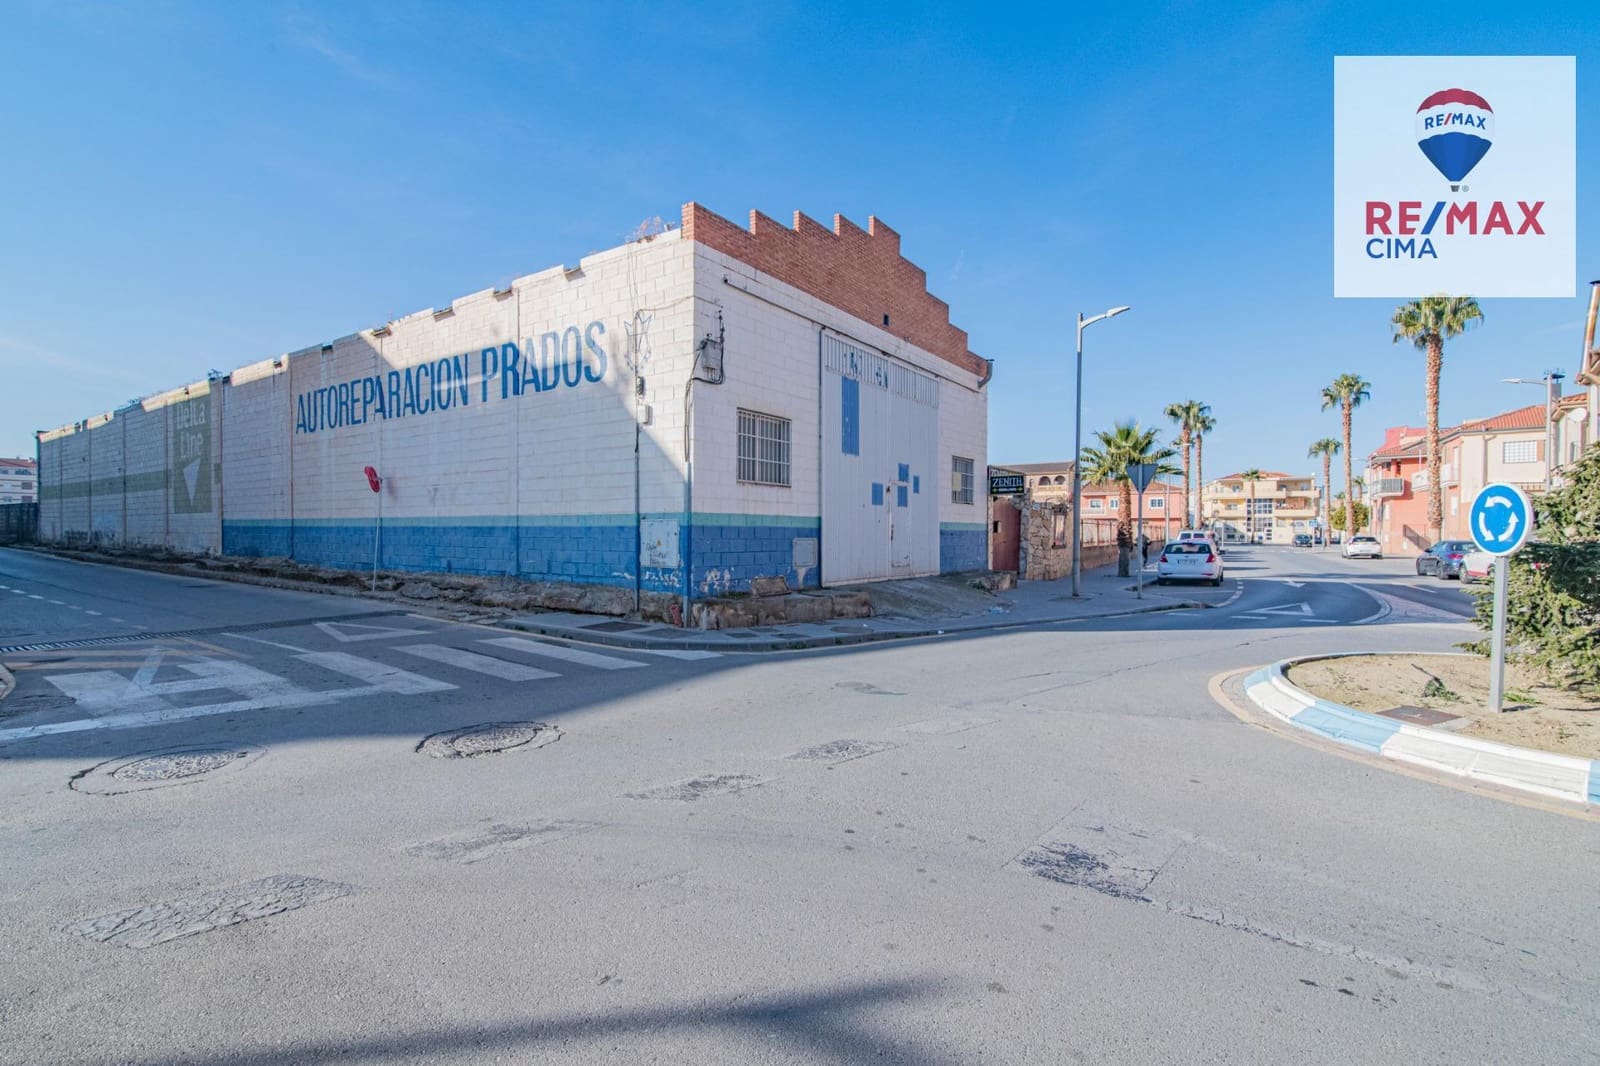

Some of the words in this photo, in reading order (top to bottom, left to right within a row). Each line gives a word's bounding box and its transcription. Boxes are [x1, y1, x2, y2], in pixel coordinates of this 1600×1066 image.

[295, 353, 470, 434] AUTOREPARACION
[481, 320, 608, 403] PRADOS
[176, 401, 206, 430] Delta
[992, 477, 1023, 487] ZENITH
